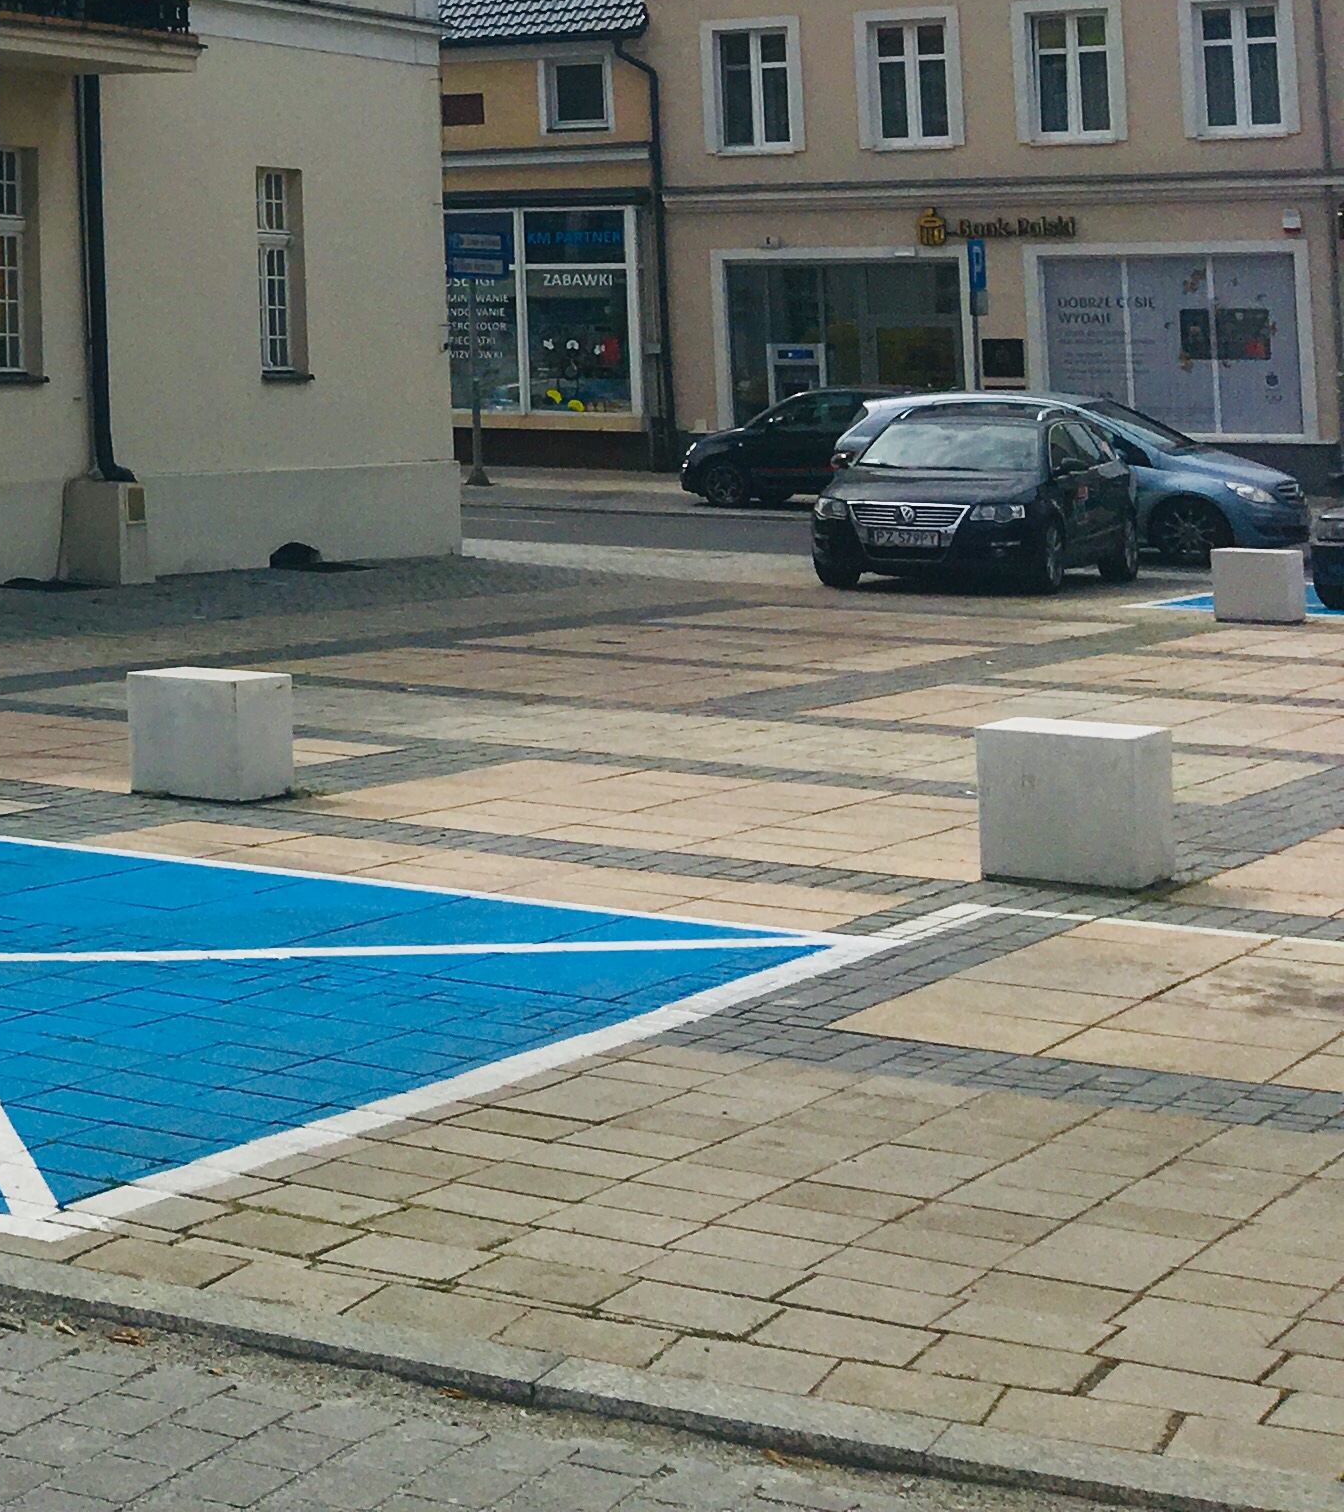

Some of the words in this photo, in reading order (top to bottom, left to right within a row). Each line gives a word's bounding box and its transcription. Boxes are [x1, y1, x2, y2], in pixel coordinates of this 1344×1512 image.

[527, 232, 551, 244] KM
[556, 231, 621, 244] PARTNER
[543, 274, 613, 286] ZABAWKI
